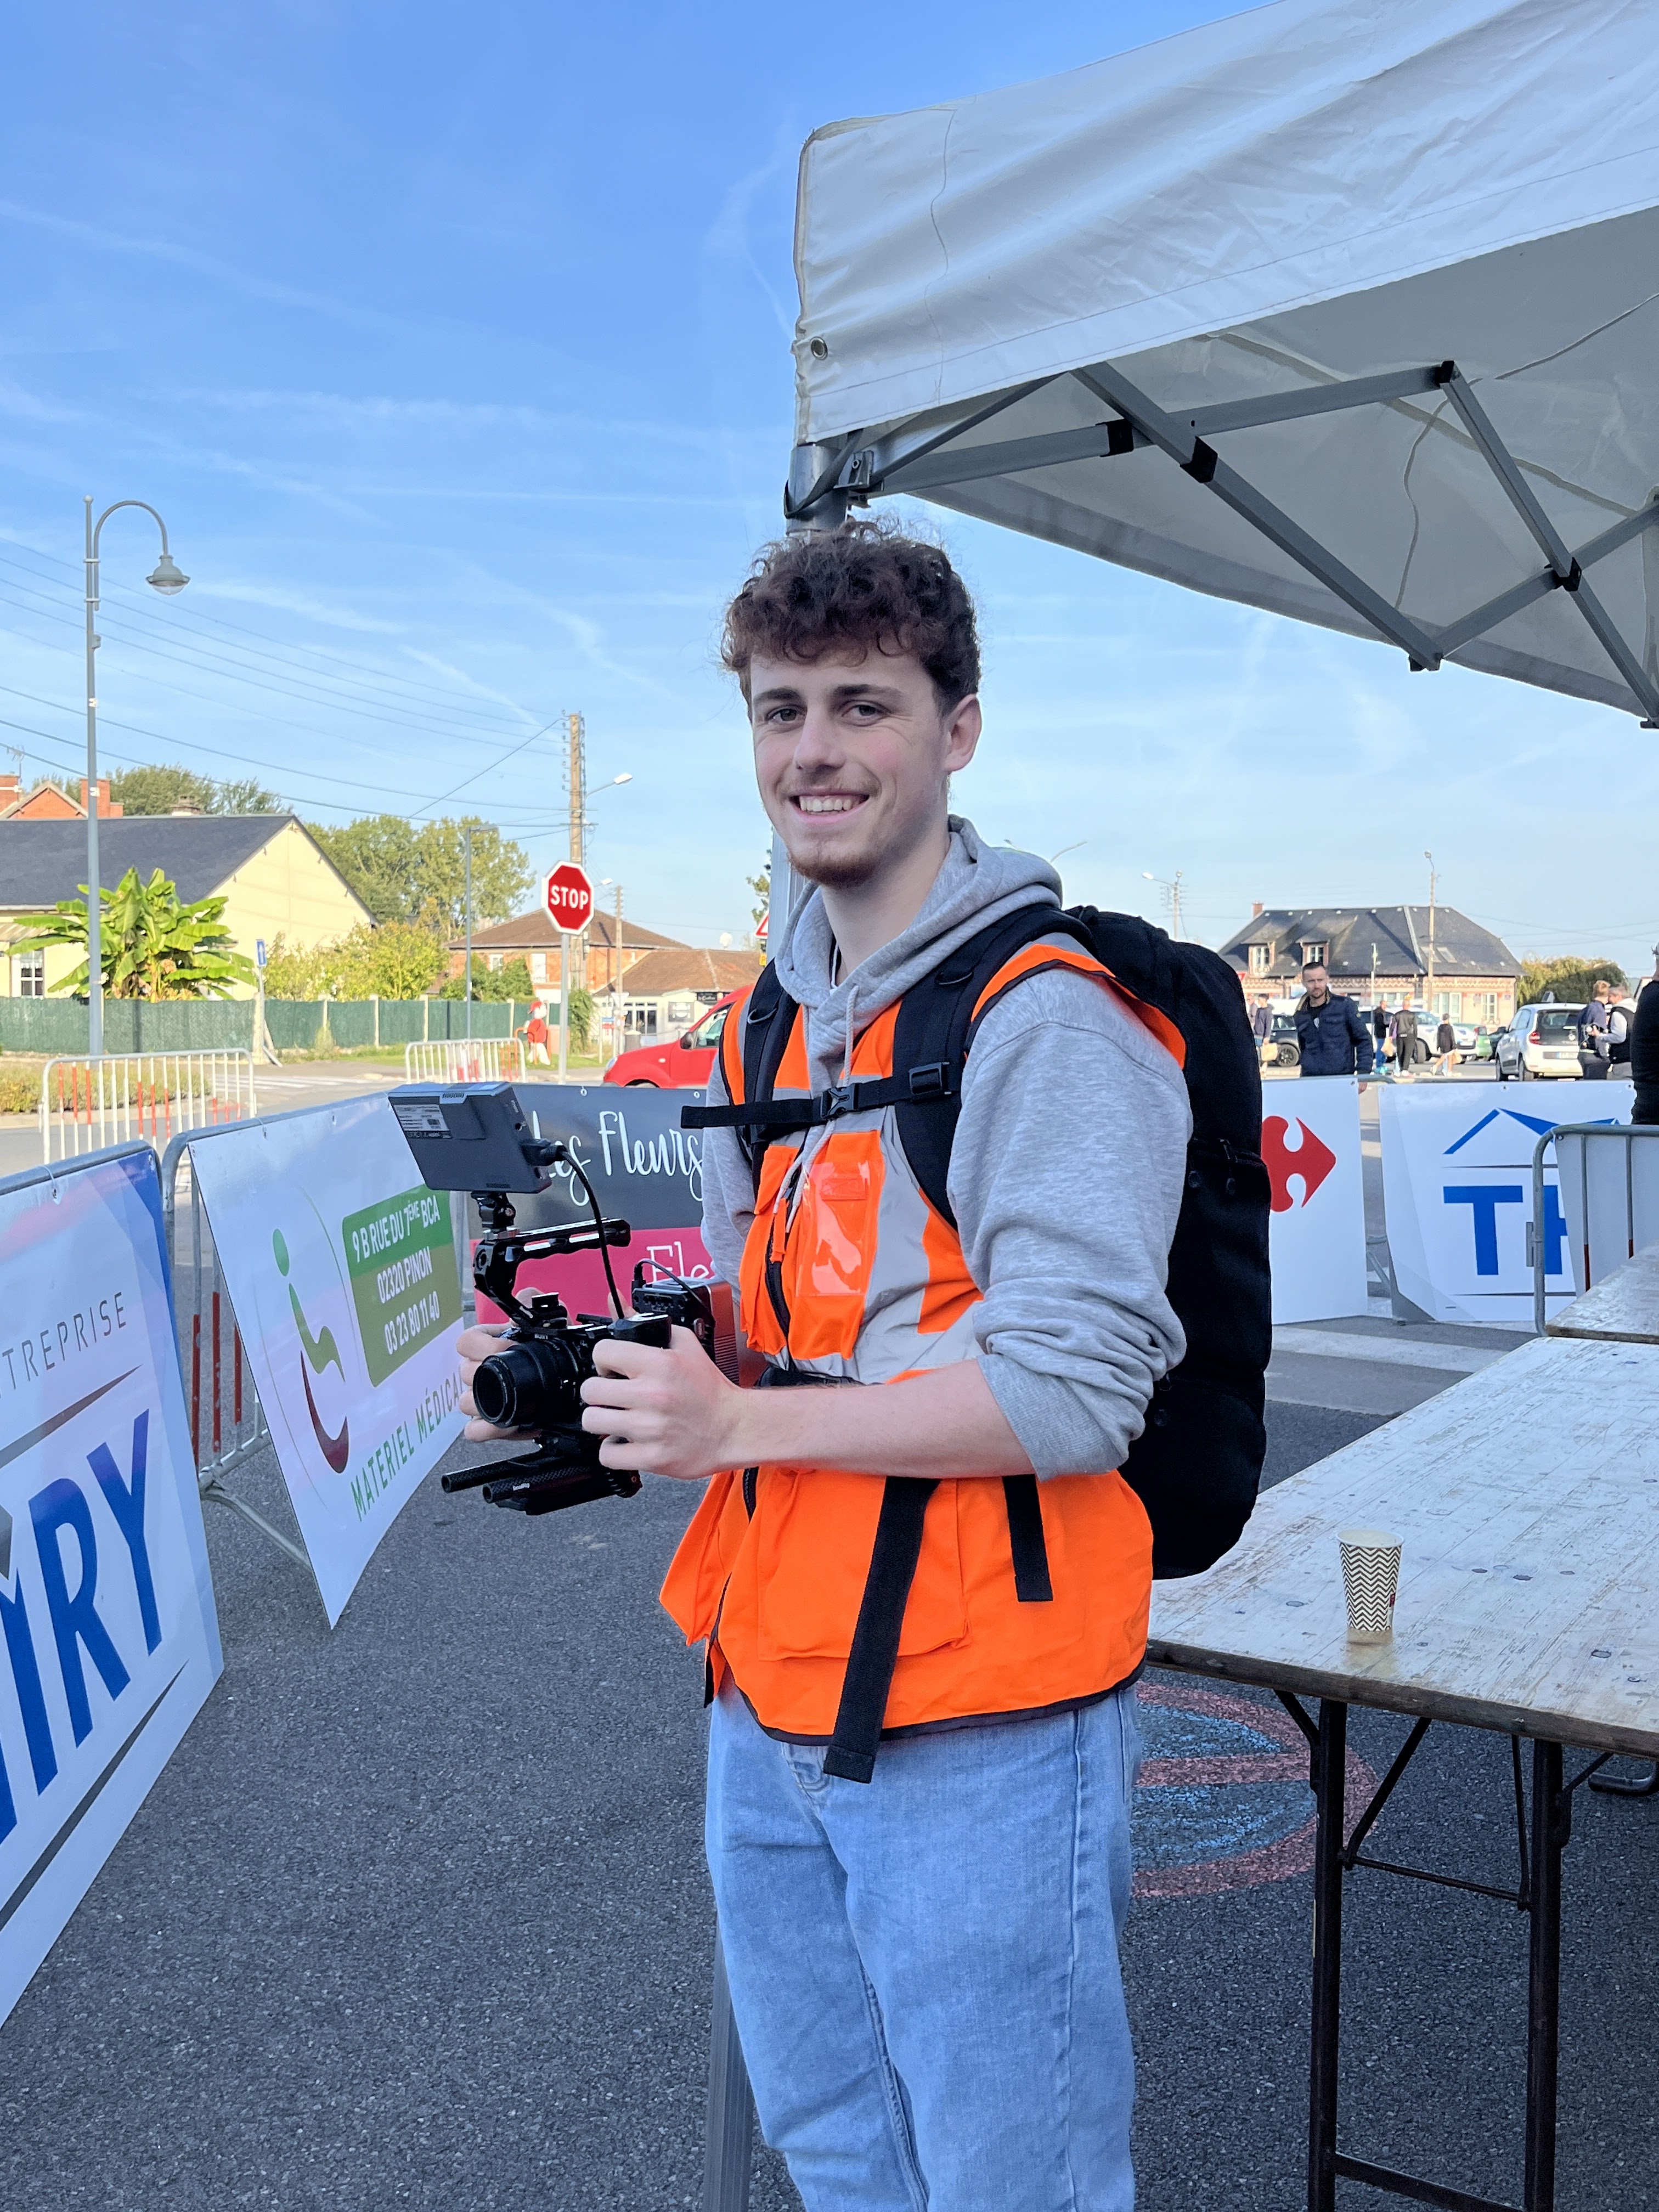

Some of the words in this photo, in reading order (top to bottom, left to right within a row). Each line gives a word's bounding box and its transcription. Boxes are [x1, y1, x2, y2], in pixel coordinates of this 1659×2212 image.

[550, 885, 589, 910] STOP
[352, 1231, 360, 1262] 9
[360, 1227, 370, 1259] B
[369, 1217, 391, 1254] RUE
[389, 1210, 405, 1244] DU
[420, 1194, 441, 1228] BCA
[377, 1261, 405, 1304] 02320
[404, 1246, 432, 1287] PINON
[0, 1291, 126, 1399] TREPRISE
[385, 1320, 398, 1355] 03
[396, 1312, 409, 1346] 23
[420, 1297, 430, 1329] 11
[430, 1290, 440, 1322] 40
[351, 1420, 415, 1522] MATERIEL
